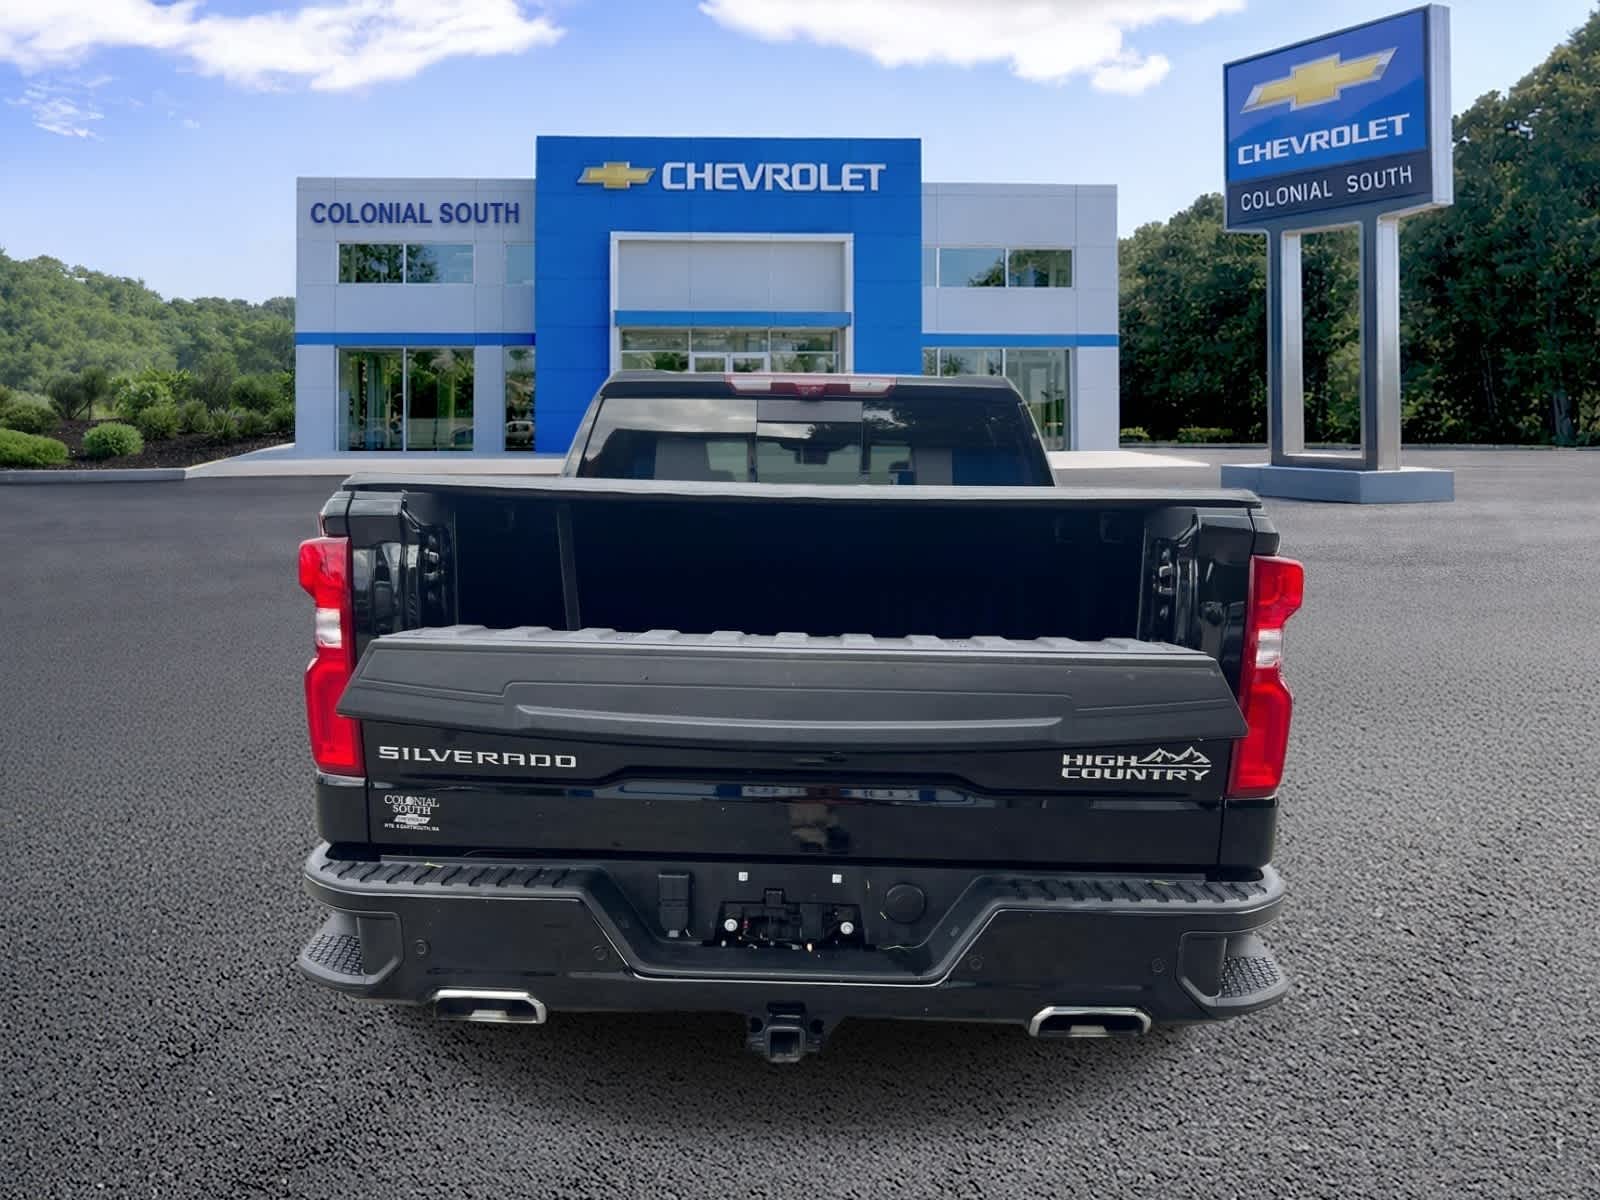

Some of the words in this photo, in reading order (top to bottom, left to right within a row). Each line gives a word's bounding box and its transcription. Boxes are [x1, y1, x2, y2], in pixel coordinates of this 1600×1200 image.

[1237, 113, 1409, 165] CHEVROLET
[661, 161, 886, 192] CHEVROLET
[1240, 180, 1333, 211] COLONIAL
[1346, 165, 1413, 193] SOUTH
[311, 202, 432, 225] COLONIAL
[439, 203, 520, 225] SOUTH
[379, 746, 577, 768] SILVERADO
[1062, 754, 1138, 766] HIGH
[1061, 767, 1210, 781] COUNTRY
[384, 794, 440, 807] COLONIAL
[392, 804, 432, 815] SOUTH
